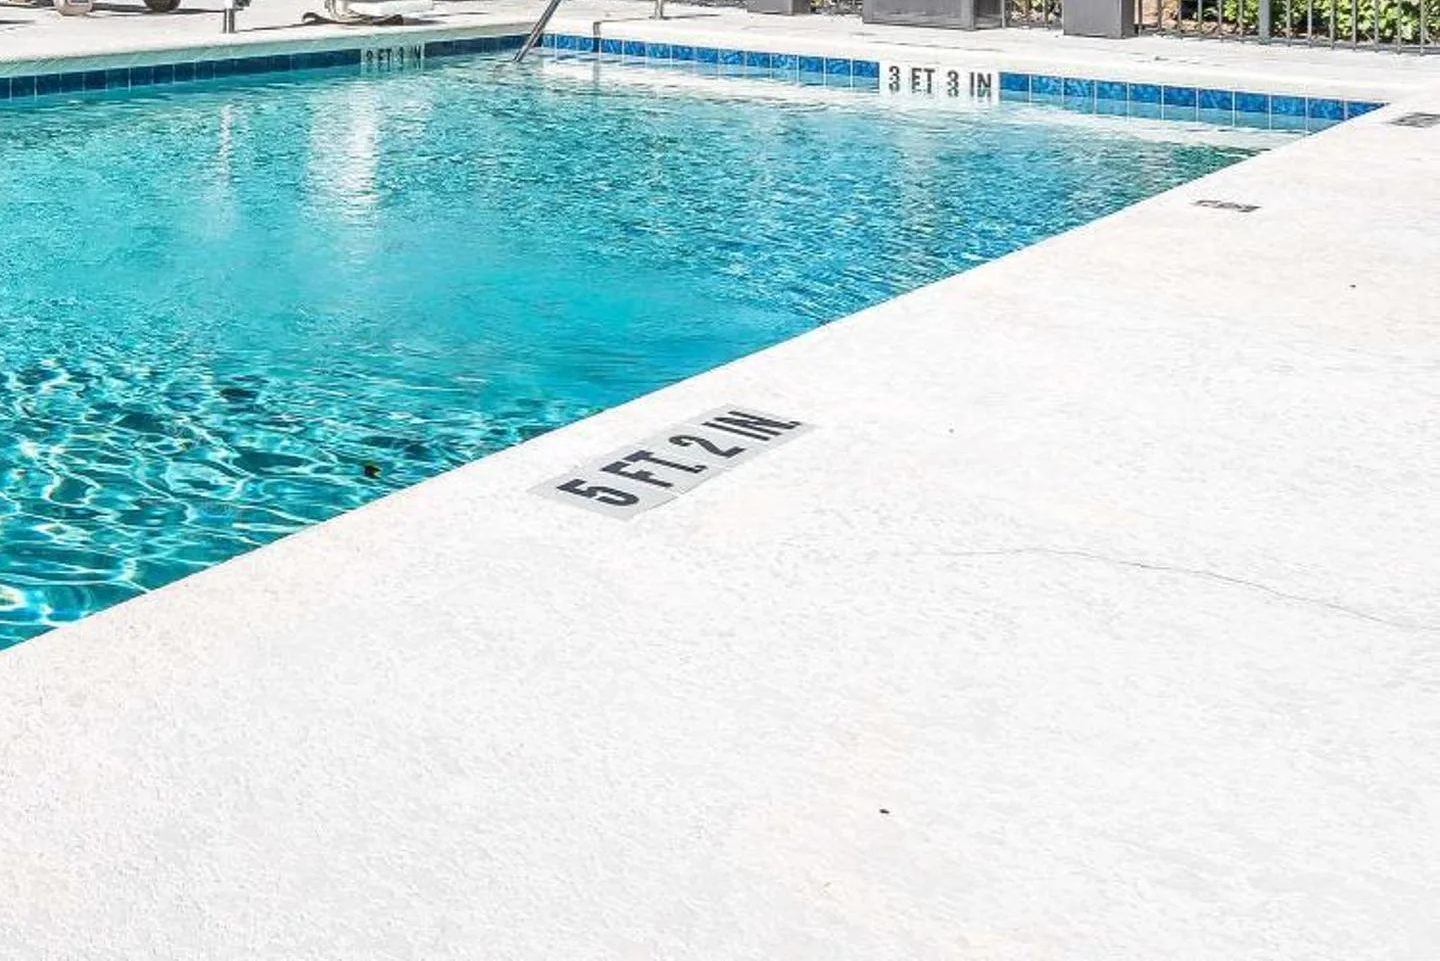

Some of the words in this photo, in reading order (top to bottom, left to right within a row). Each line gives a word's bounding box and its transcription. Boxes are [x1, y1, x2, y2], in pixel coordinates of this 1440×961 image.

[969, 71, 991, 92] IN
[556, 478, 640, 507] 5
[668, 434, 747, 459] 2
